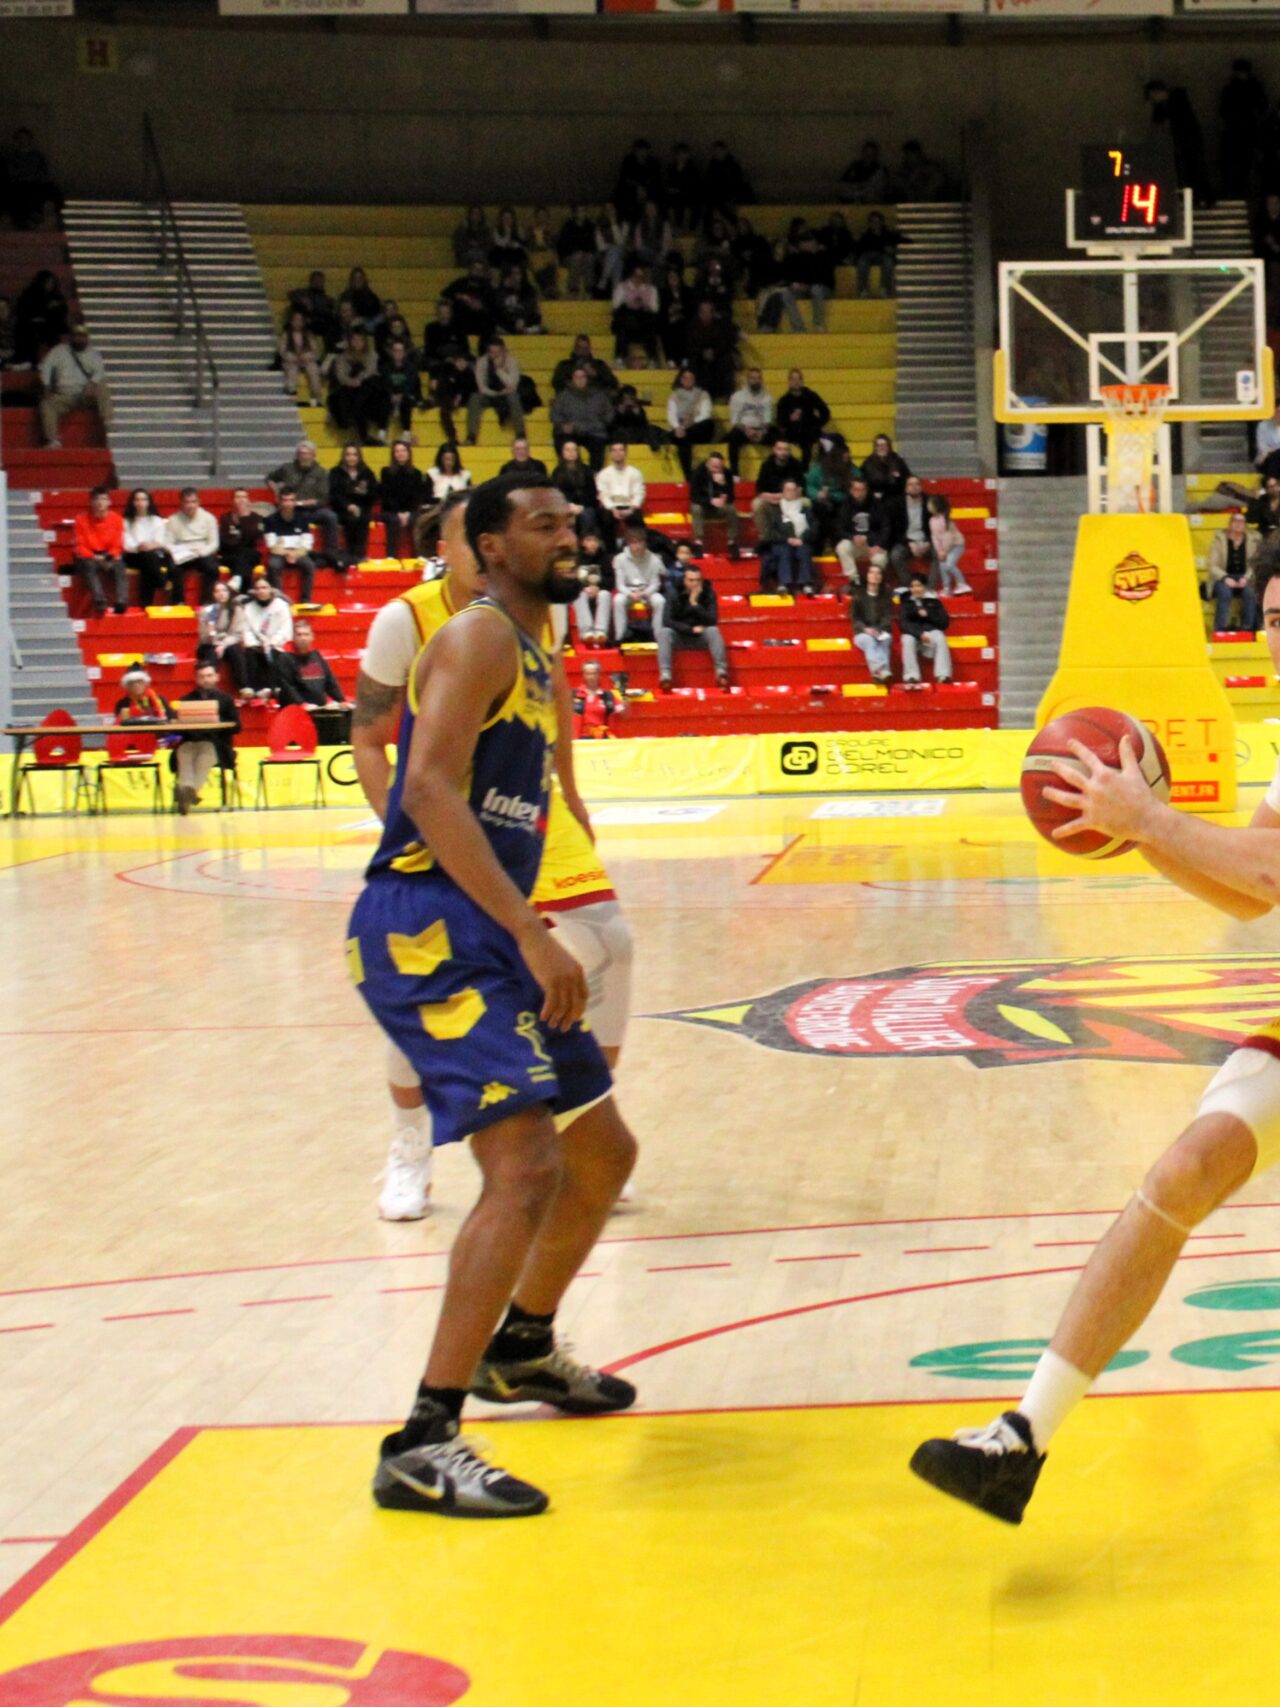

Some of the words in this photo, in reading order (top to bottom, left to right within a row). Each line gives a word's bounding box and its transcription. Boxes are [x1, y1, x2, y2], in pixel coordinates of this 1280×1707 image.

[86, 39, 109, 66] H
[1121, 183, 1157, 224] 14
[826, 747, 964, 761] DELMONICO
[826, 763, 908, 775] DOREL
